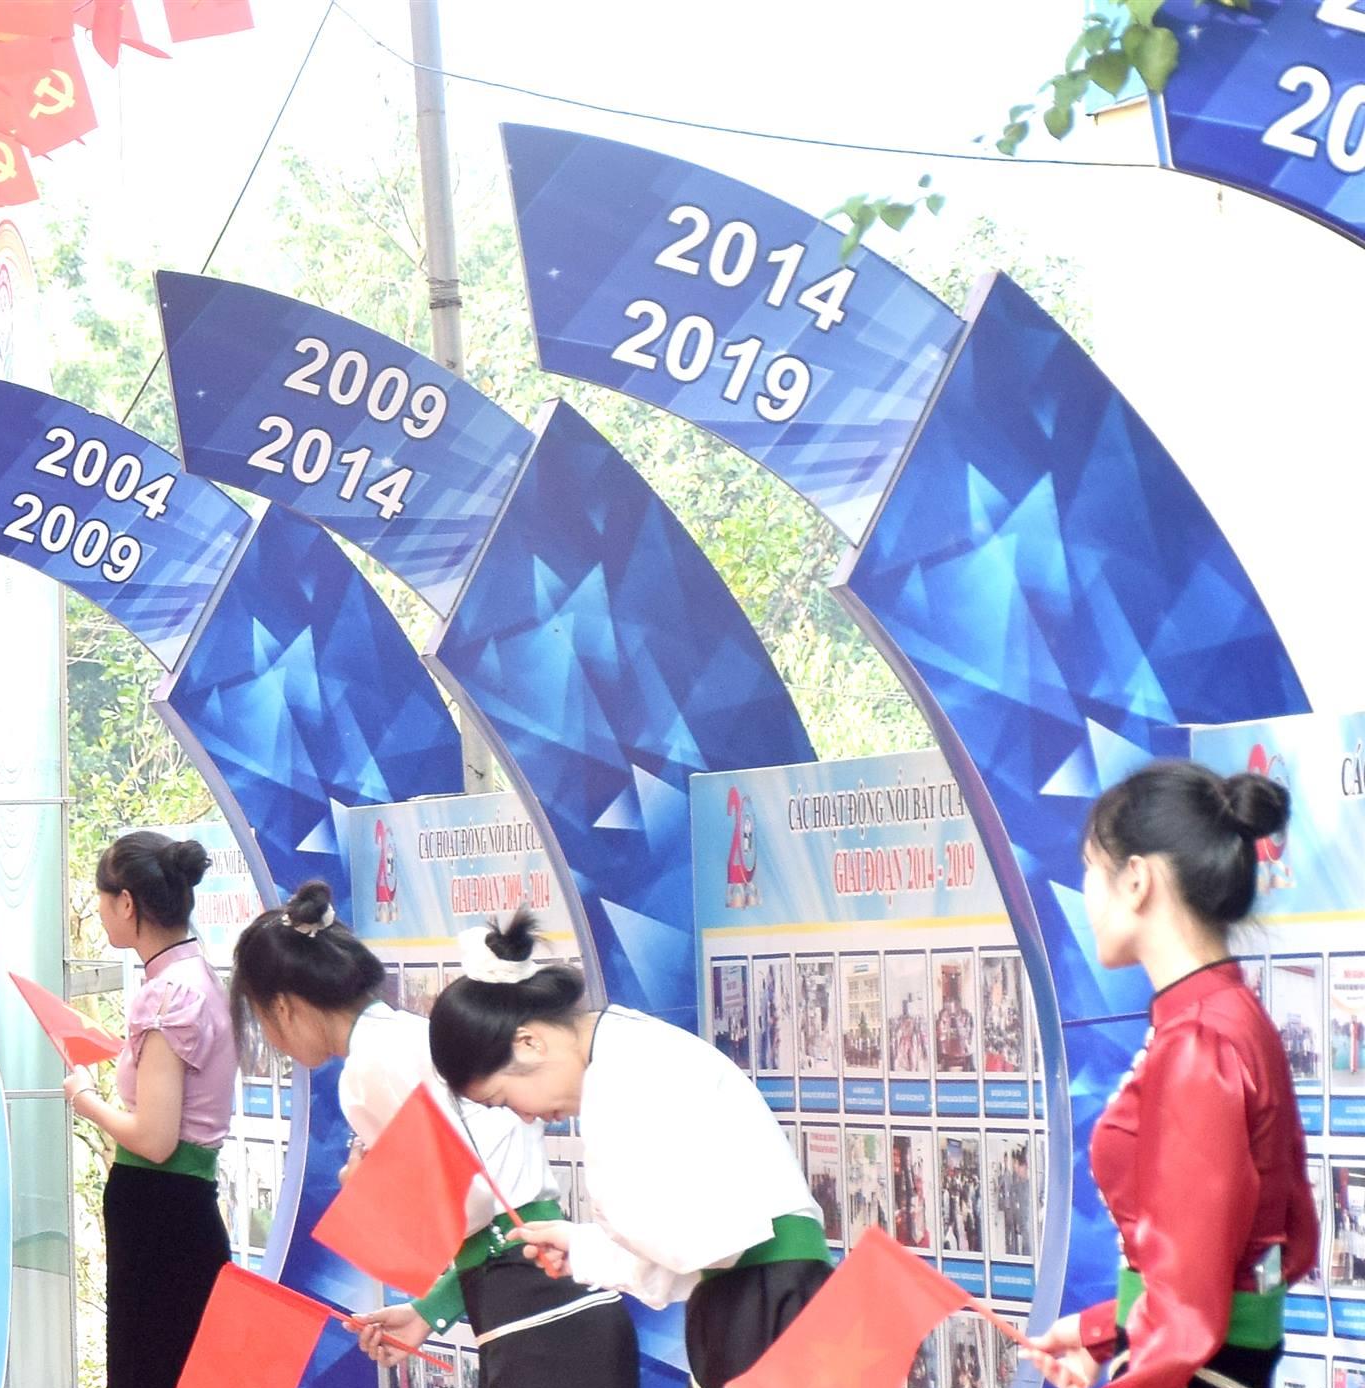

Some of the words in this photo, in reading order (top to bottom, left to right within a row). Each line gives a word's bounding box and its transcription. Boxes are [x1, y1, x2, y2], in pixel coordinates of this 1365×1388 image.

[1261, 64, 1365, 173] 20
[653, 204, 857, 332] 2014
[283, 337, 449, 440] 2009
[610, 298, 812, 423] 2019
[35, 426, 176, 520] 2004
[247, 415, 413, 521] 2014
[3, 493, 142, 583] 2009
[788, 787, 810, 830] CÁC
[813, 794, 846, 838] HOẠT
[848, 783, 884, 836] ĐỘNG
[913, 776, 936, 831] BẬT
[1341, 743, 1365, 796] CÁ
[452, 877, 470, 914] GIAI
[530, 872, 551, 910] 2014
[834, 851, 862, 895] GIAI
[865, 848, 903, 905] ĐOẠN
[907, 847, 935, 890] 2014
[945, 842, 975, 888] 2019
